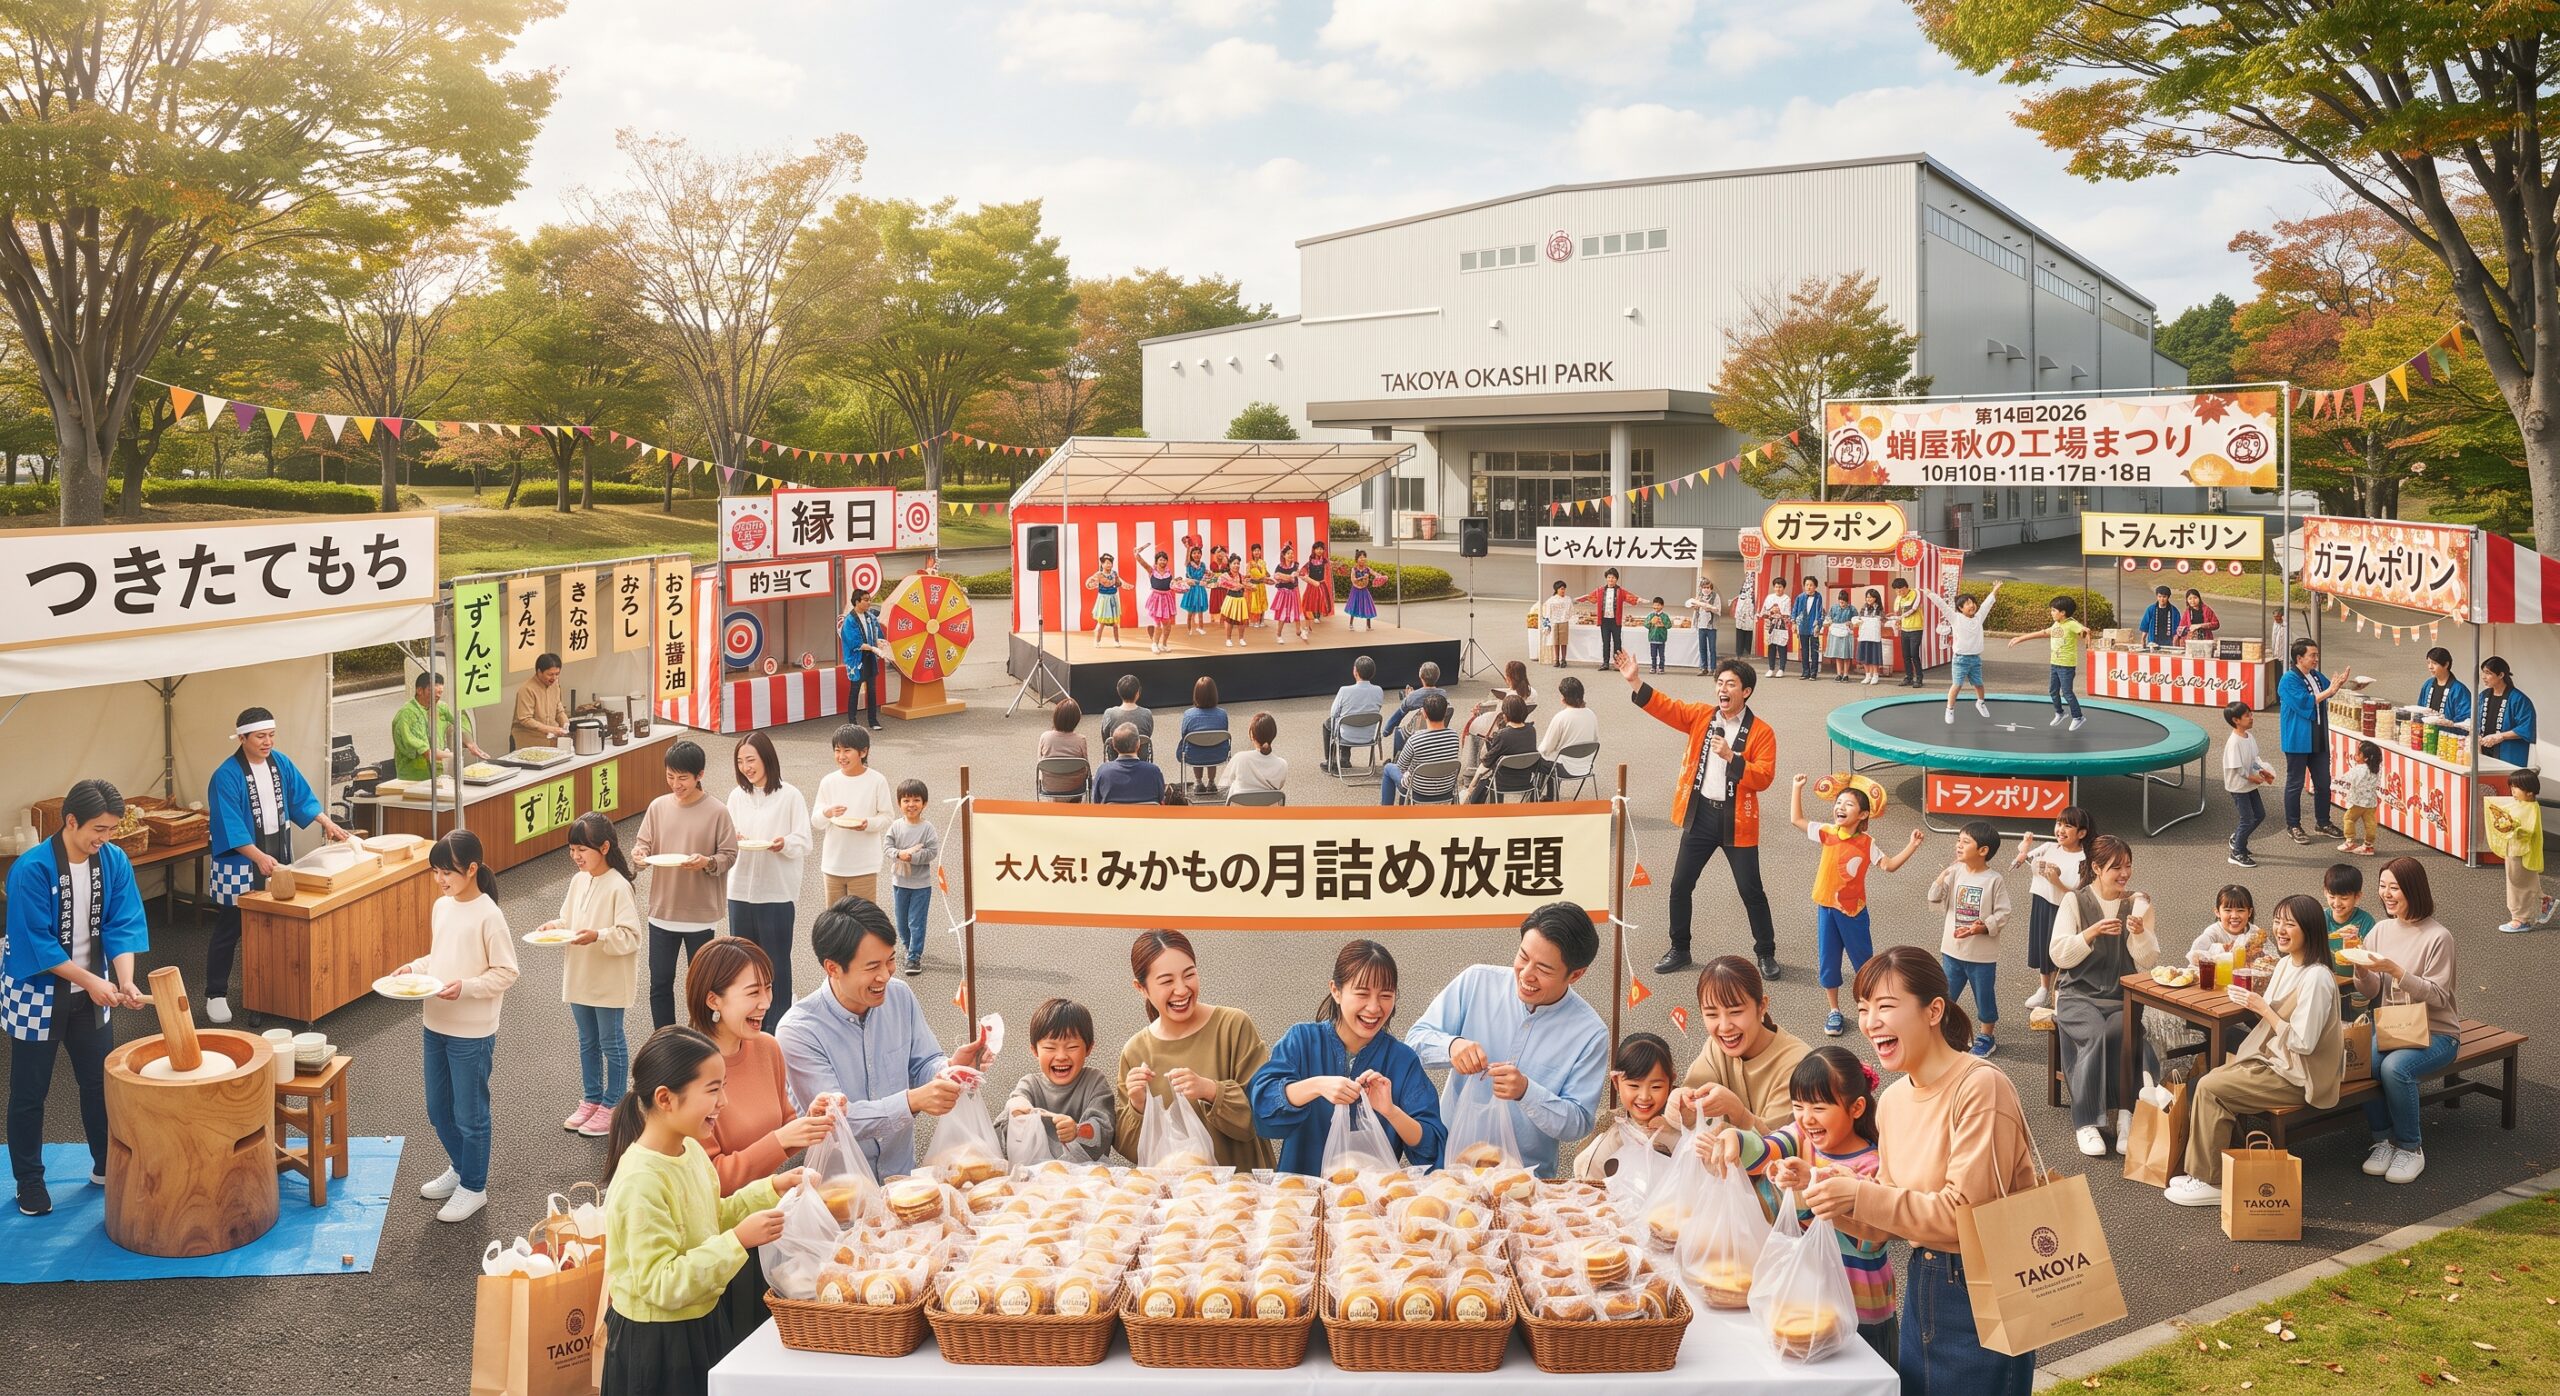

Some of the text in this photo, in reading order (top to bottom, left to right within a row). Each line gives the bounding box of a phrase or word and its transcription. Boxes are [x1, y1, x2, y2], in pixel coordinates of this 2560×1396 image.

[1381, 360, 1614, 392] TAKOYA OKASHI PARK
[1886, 425, 2192, 460] 蛸屋秋の工場まつり
[791, 499, 876, 546] 縁日
[1776, 511, 1892, 541] ガラポン
[2101, 521, 2247, 550] トラんポリン
[1543, 535, 1698, 561] じゃんけん大会
[26, 533, 407, 616] つきたてもち
[750, 569, 812, 594] 的当て
[2314, 541, 2455, 593] ガラんポリン
[568, 581, 589, 652] きな粉
[464, 593, 493, 695] ずんだ
[1936, 780, 2065, 811] トランポリン
[995, 836, 1565, 901] 大人気! みかもの月詰め放題
[2243, 1199, 2291, 1209] TAKOYA
[2014, 1252, 2091, 1288] TAKOYA
[546, 1334, 593, 1360] TAKOY
